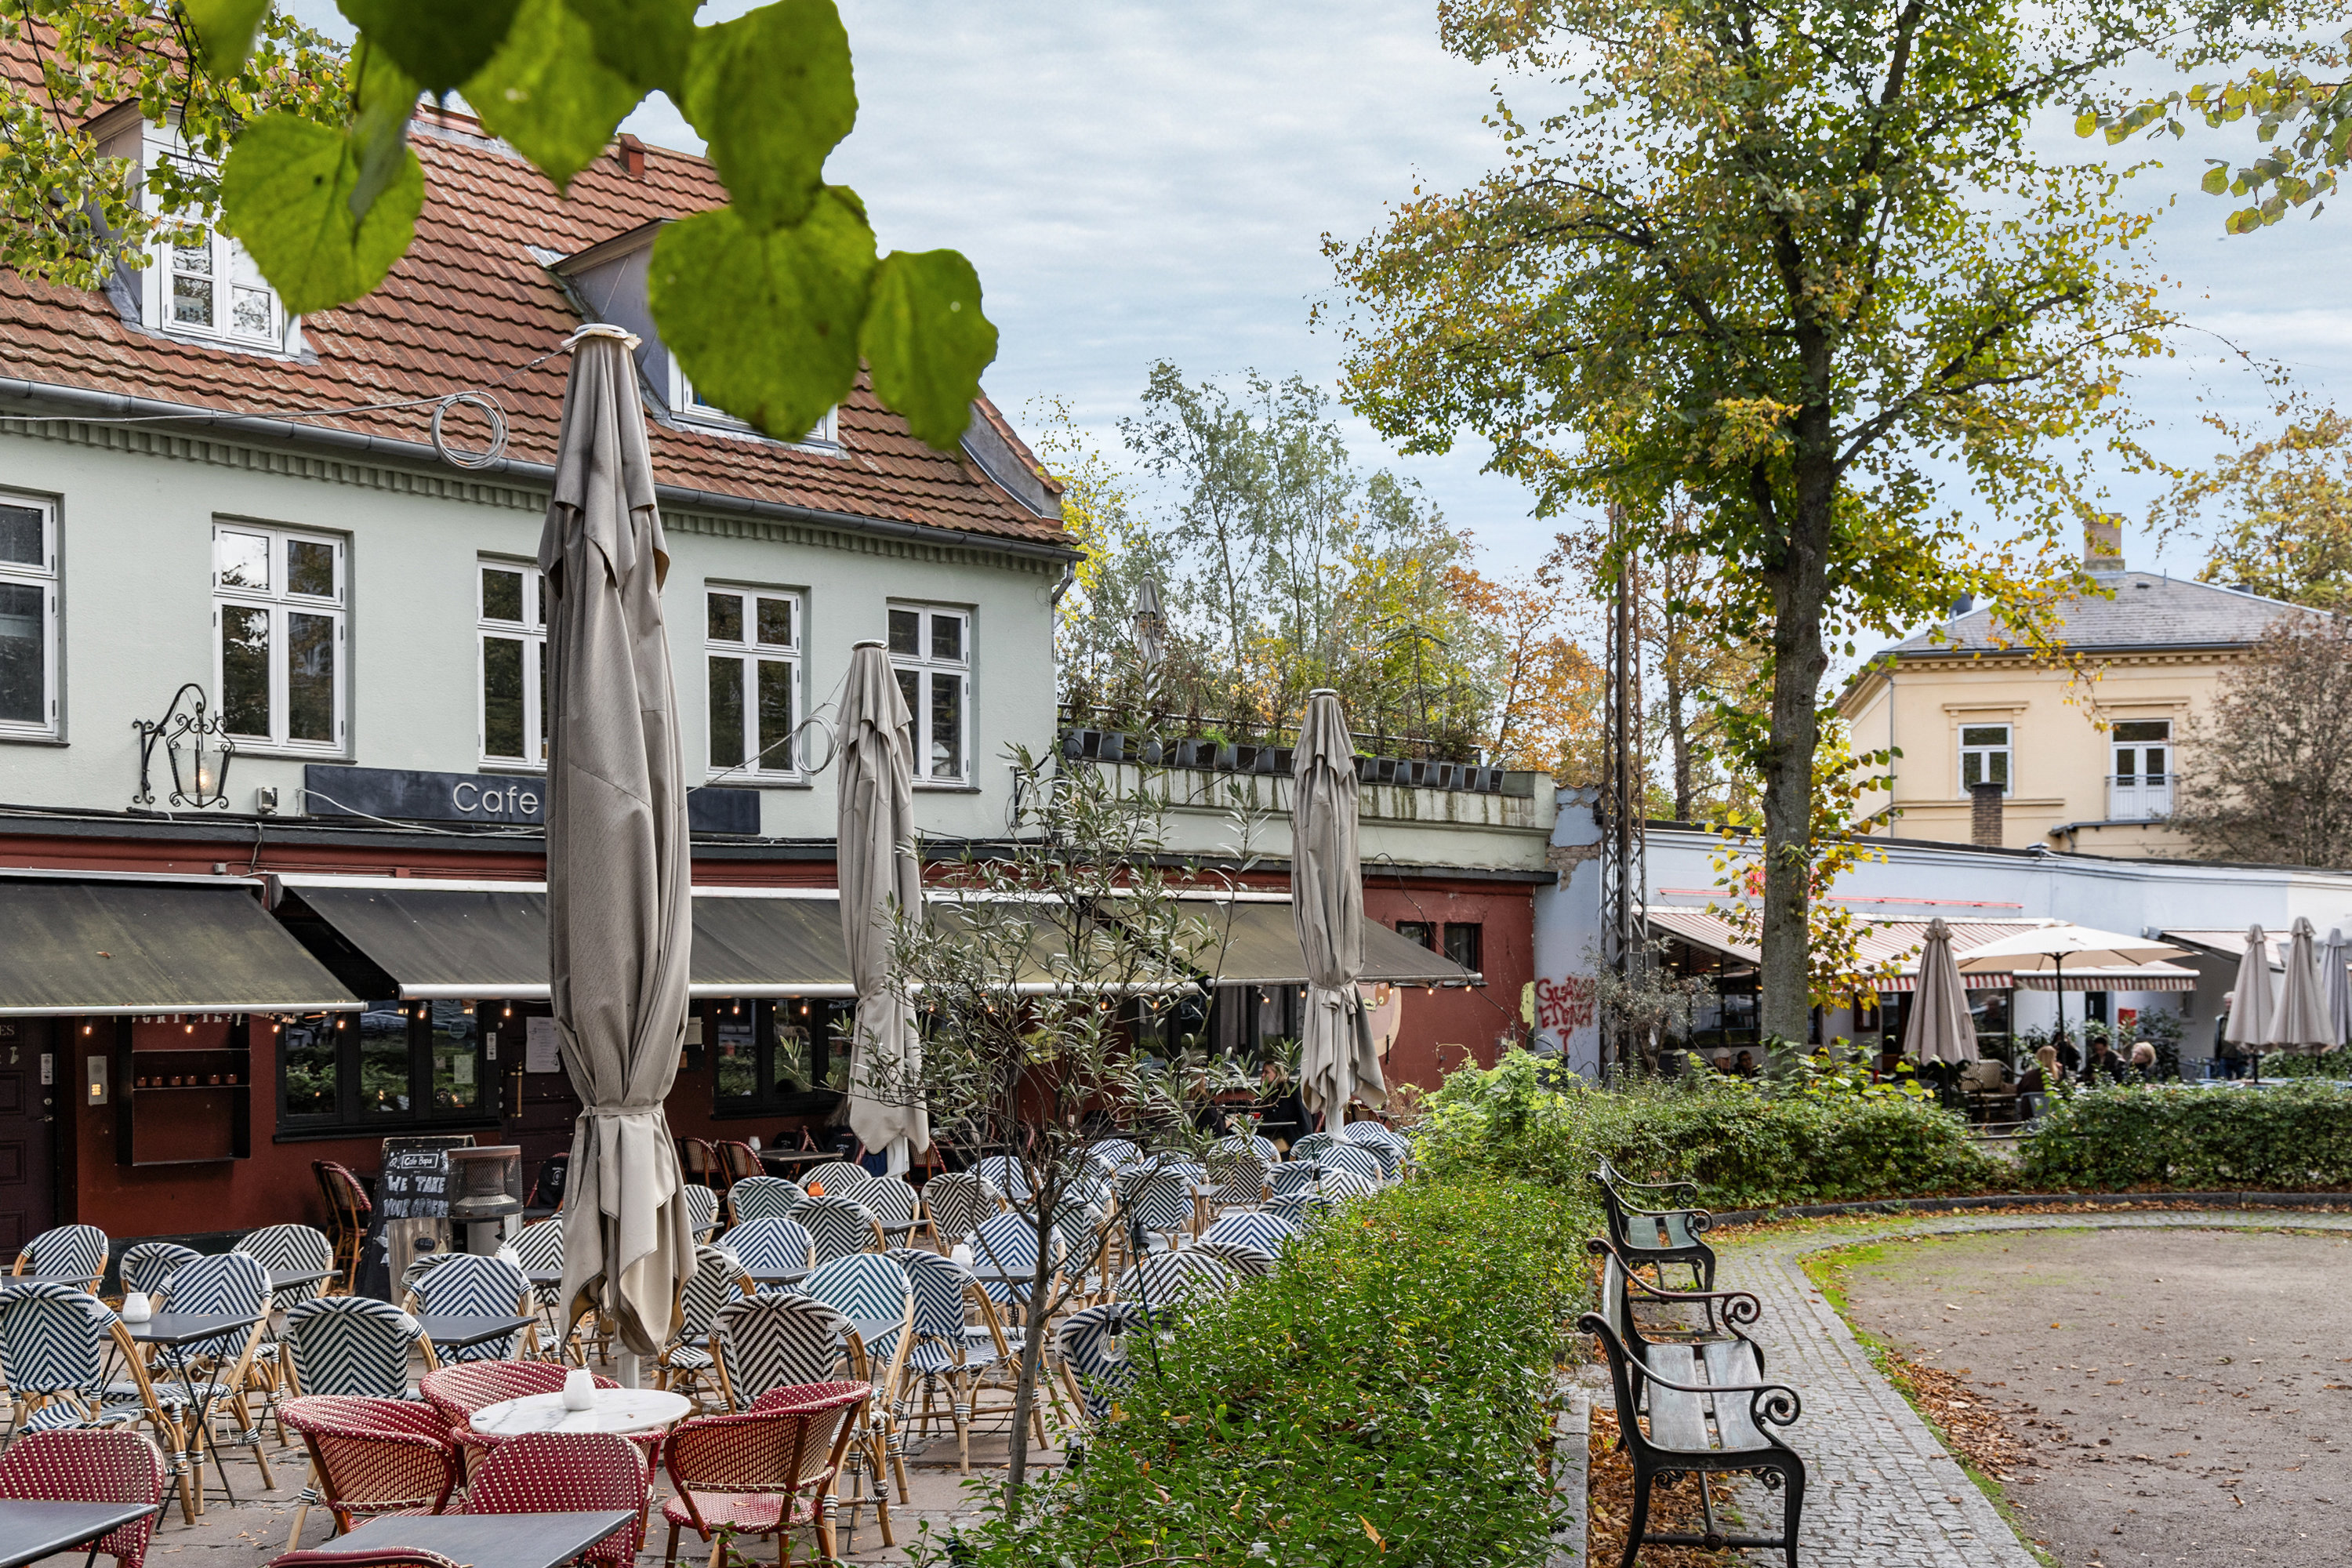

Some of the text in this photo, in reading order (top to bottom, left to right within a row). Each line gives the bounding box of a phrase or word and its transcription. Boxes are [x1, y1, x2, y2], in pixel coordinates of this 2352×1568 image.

[452, 782, 539, 815] Cafe
[388, 1175, 445, 1192] WE TAKE
[383, 1198, 410, 1218] YOUR
